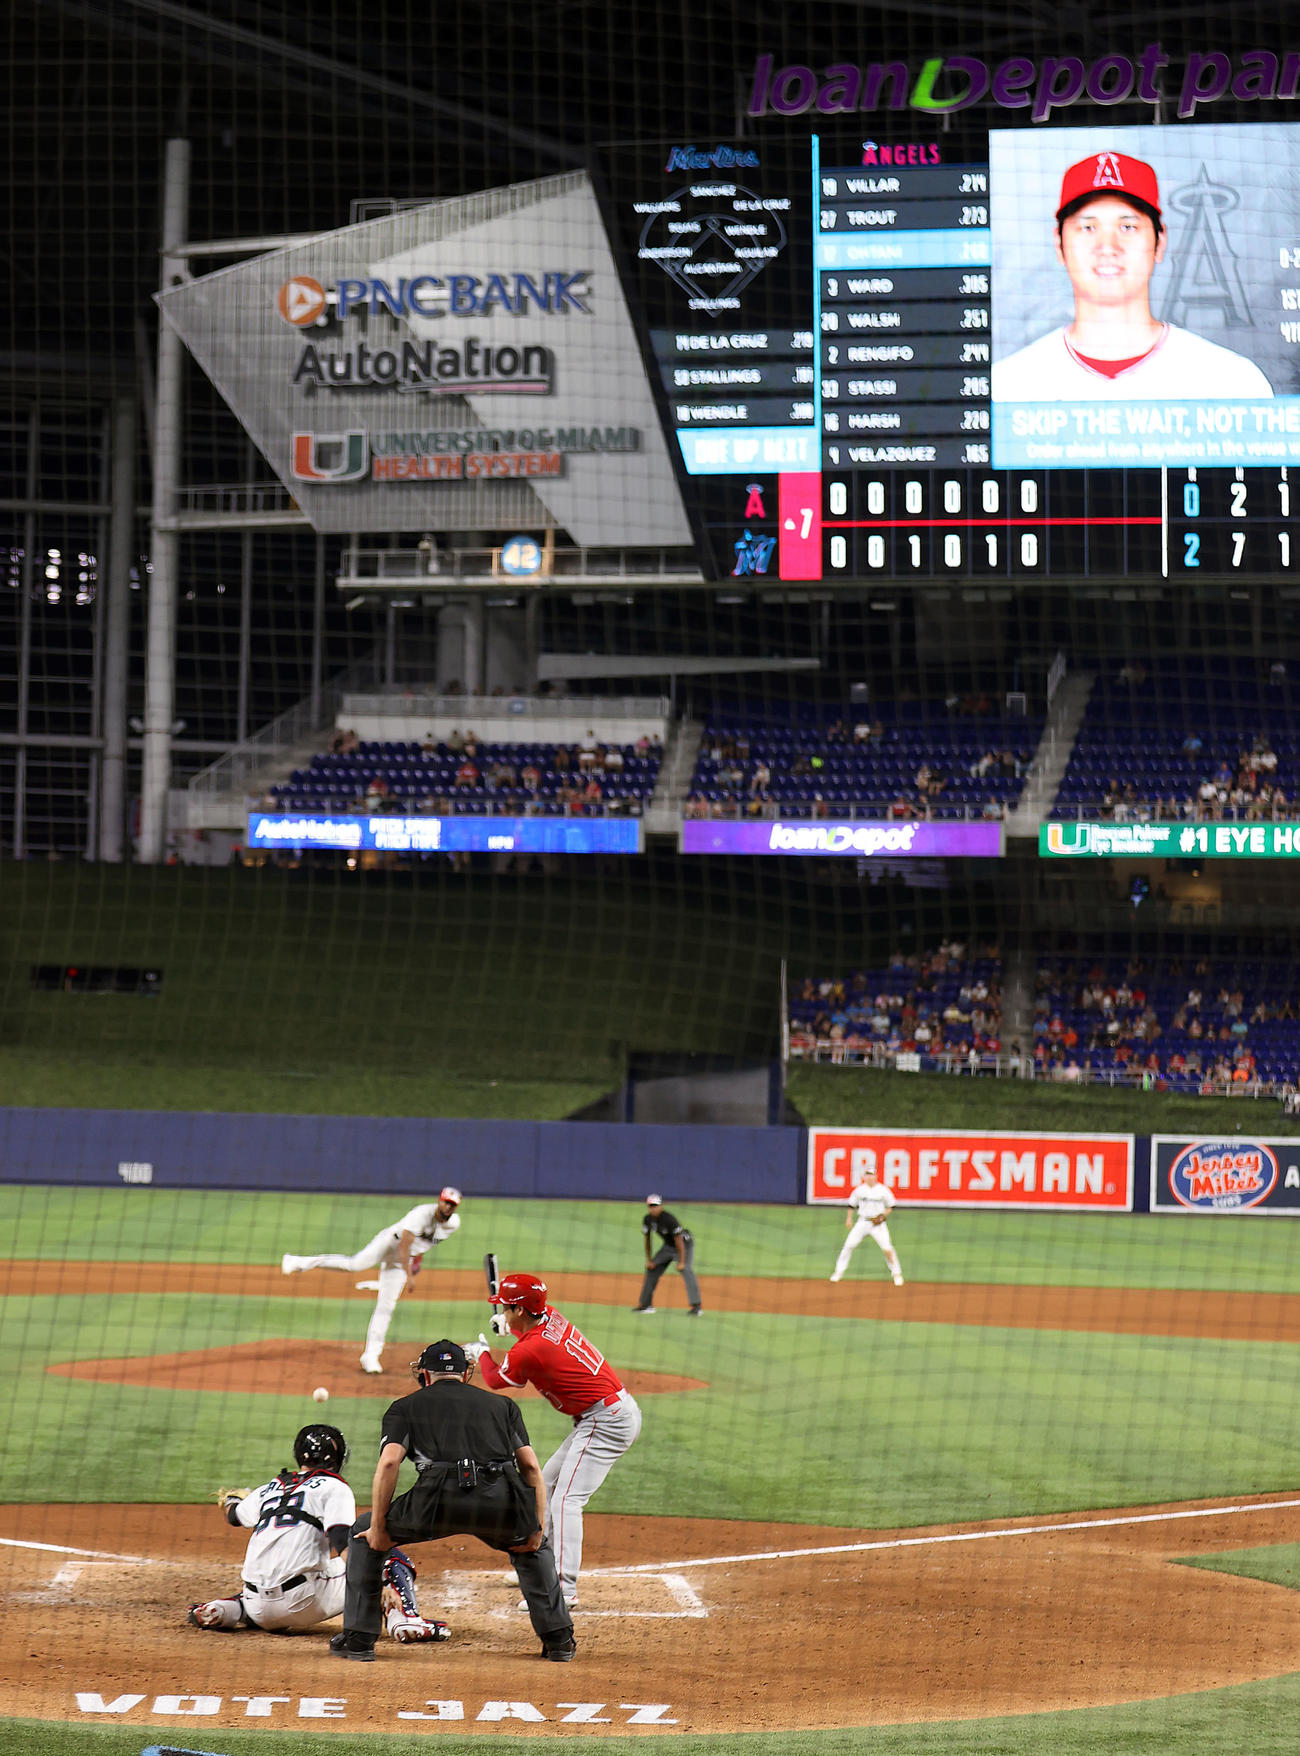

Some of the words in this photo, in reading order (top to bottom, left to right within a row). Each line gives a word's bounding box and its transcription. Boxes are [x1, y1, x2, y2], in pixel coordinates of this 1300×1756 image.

[748, 43, 1169, 123] loanDepot
[862, 141, 941, 166] ANGELS
[845, 177, 901, 194] VILLAR
[846, 209, 898, 226] TROUT
[847, 278, 895, 294] WARD
[847, 312, 901, 328] WALSH
[293, 338, 549, 384] AutoNation
[847, 346, 915, 362] RENGIFO
[690, 369, 762, 384] STALLINGS
[847, 379, 898, 396] STASSI
[690, 404, 749, 420] WENDLE
[847, 412, 901, 429] MARSH
[1011, 408, 1068, 435] SKIP
[1071, 407, 1121, 434] THE
[1124, 407, 1192, 438] WAIT,
[1196, 406, 1248, 433] NOT
[1250, 406, 1300, 433] THE
[374, 430, 514, 453] UNIVERSITY
[517, 429, 551, 450] OF
[554, 427, 640, 451] MIAMI
[372, 455, 463, 481] HEALTH
[465, 452, 563, 478] SYSTEM
[847, 446, 937, 463] VELAZQUEZ
[829, 482, 847, 515] 0
[867, 481, 885, 514] 0
[905, 481, 923, 514] 0
[944, 480, 961, 513] 0
[982, 480, 999, 513] 0
[1021, 479, 1038, 512] 0
[1184, 482, 1200, 517] 0
[1230, 482, 1247, 517] 2
[1278, 482, 1290, 517] 1
[502, 541, 539, 568] 42
[830, 535, 847, 568] 0
[868, 535, 885, 568] 0
[908, 534, 921, 568] 1
[944, 534, 961, 567] 0
[985, 534, 998, 568] 1
[1021, 533, 1038, 567] 0
[1184, 533, 1200, 567] 2
[1231, 532, 1246, 567] 7
[1278, 532, 1290, 567] 1
[769, 823, 915, 856] loanDepot
[1179, 827, 1208, 853] #1
[1215, 827, 1266, 853] EYE
[823, 1147, 1105, 1195] CRAFTSMAN
[1183, 1151, 1263, 1179] Jersey
[1190, 1172, 1264, 1201] Mike's
[564, 1324, 604, 1376] 17
[75, 1692, 348, 1719] VOTE
[397, 1699, 679, 1725] JAZZ
